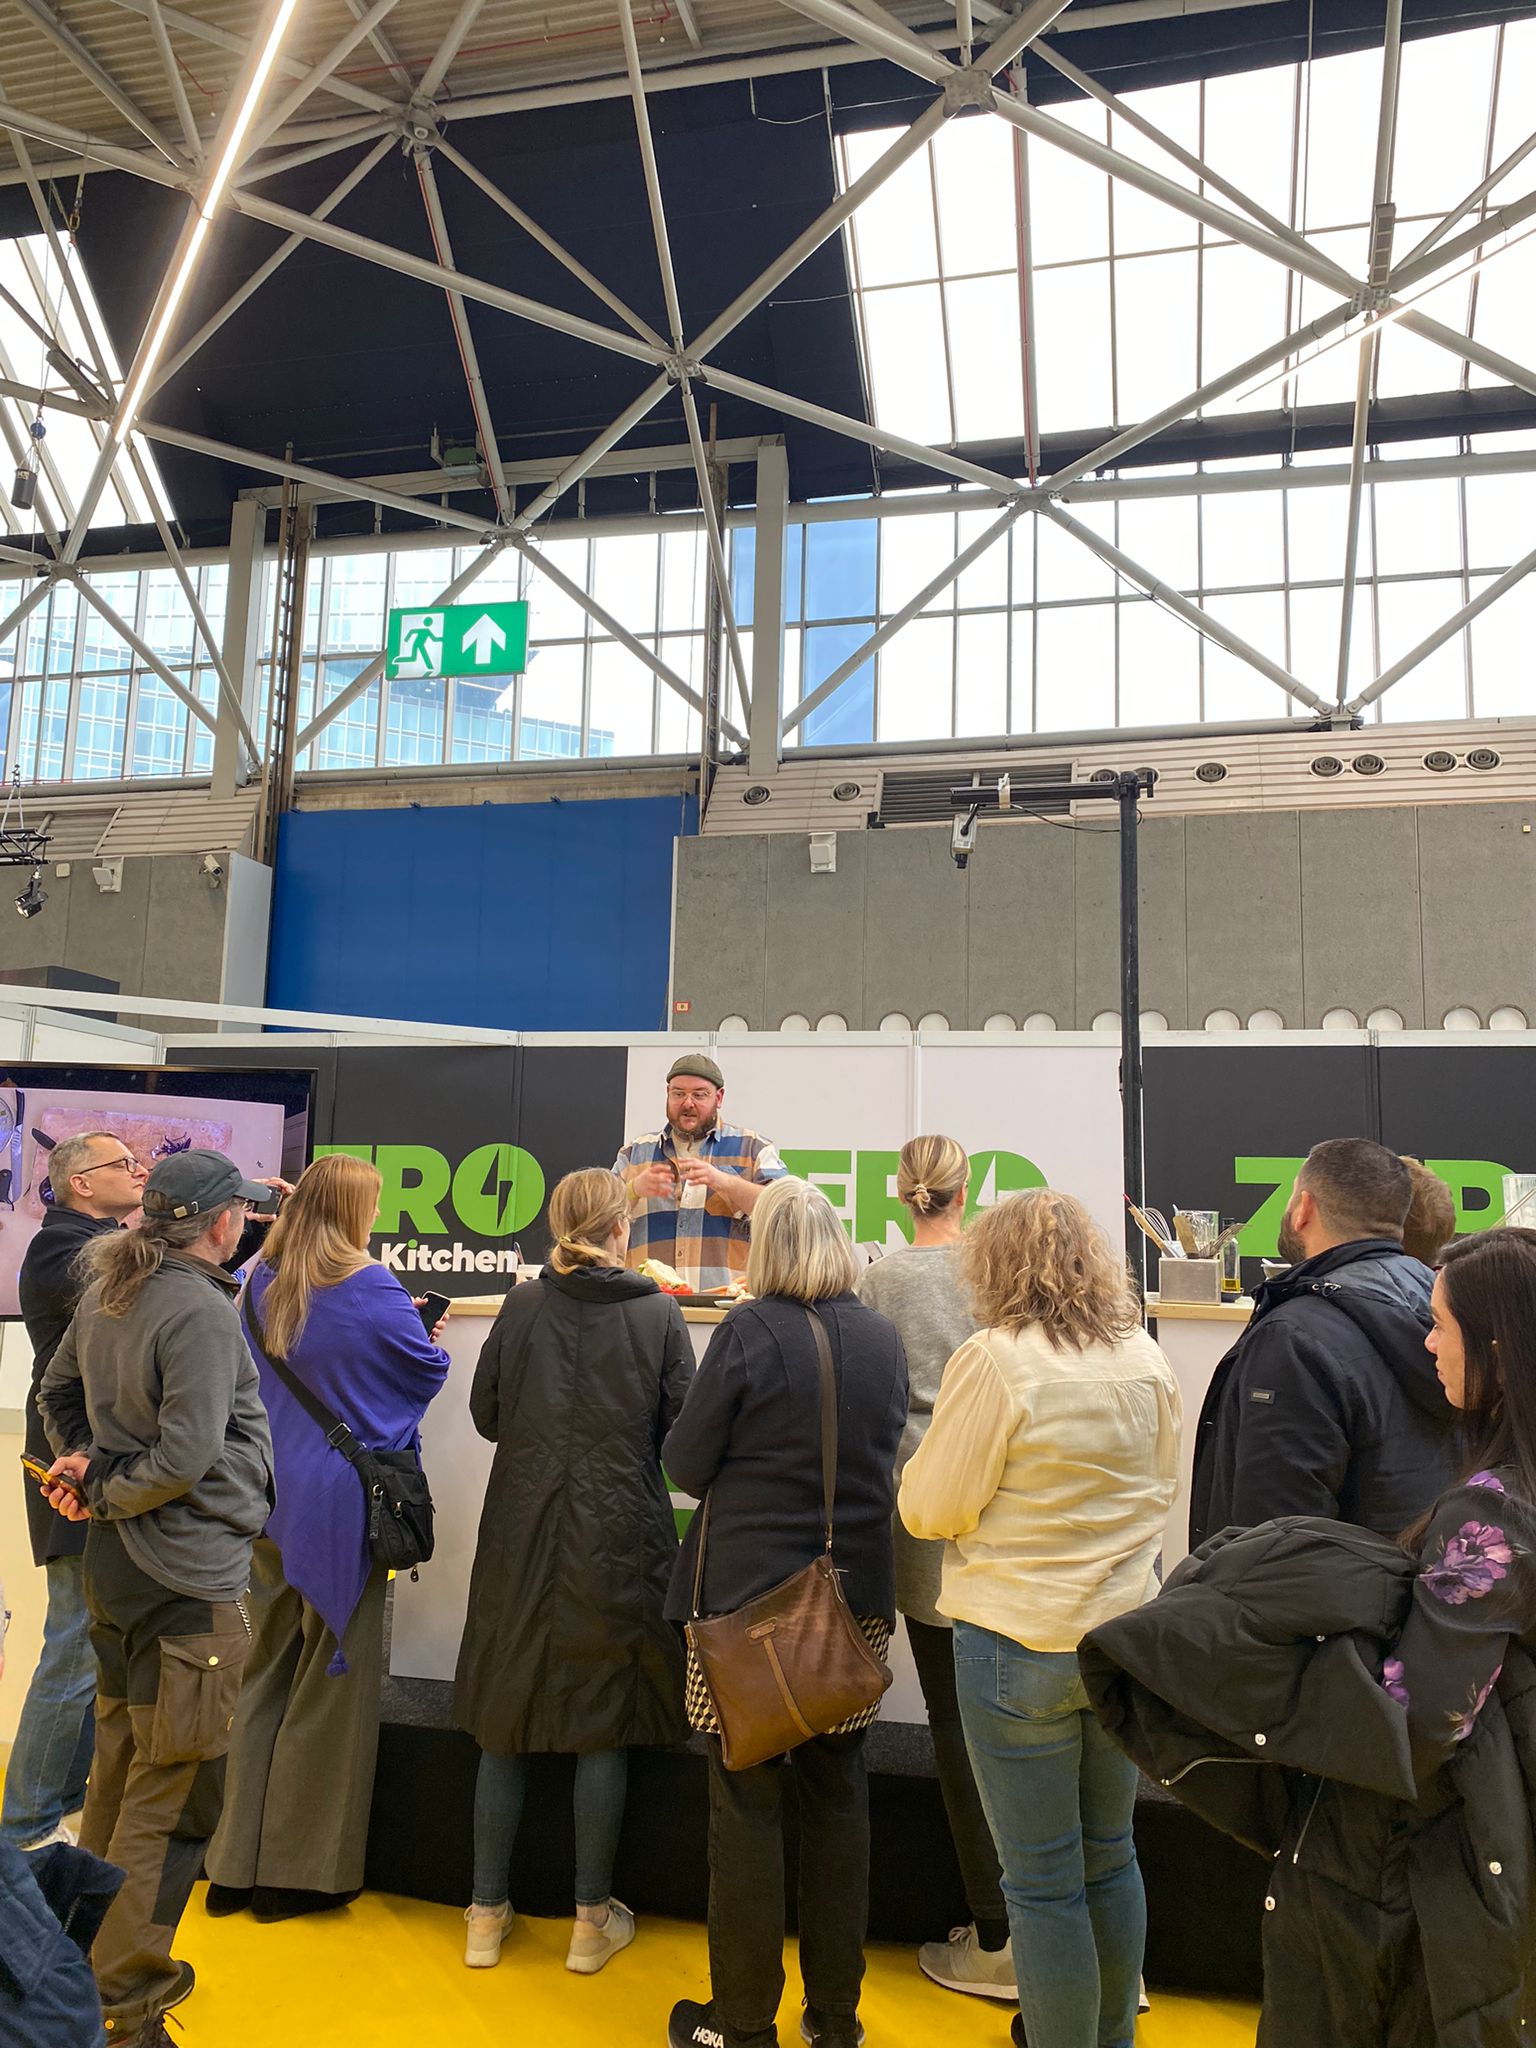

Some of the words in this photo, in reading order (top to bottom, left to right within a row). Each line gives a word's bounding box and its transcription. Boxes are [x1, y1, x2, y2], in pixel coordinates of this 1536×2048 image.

[313, 1143, 546, 1237] RO
[381, 1238, 518, 1273] Kitchen
[692, 2025, 725, 2048] HOKA
